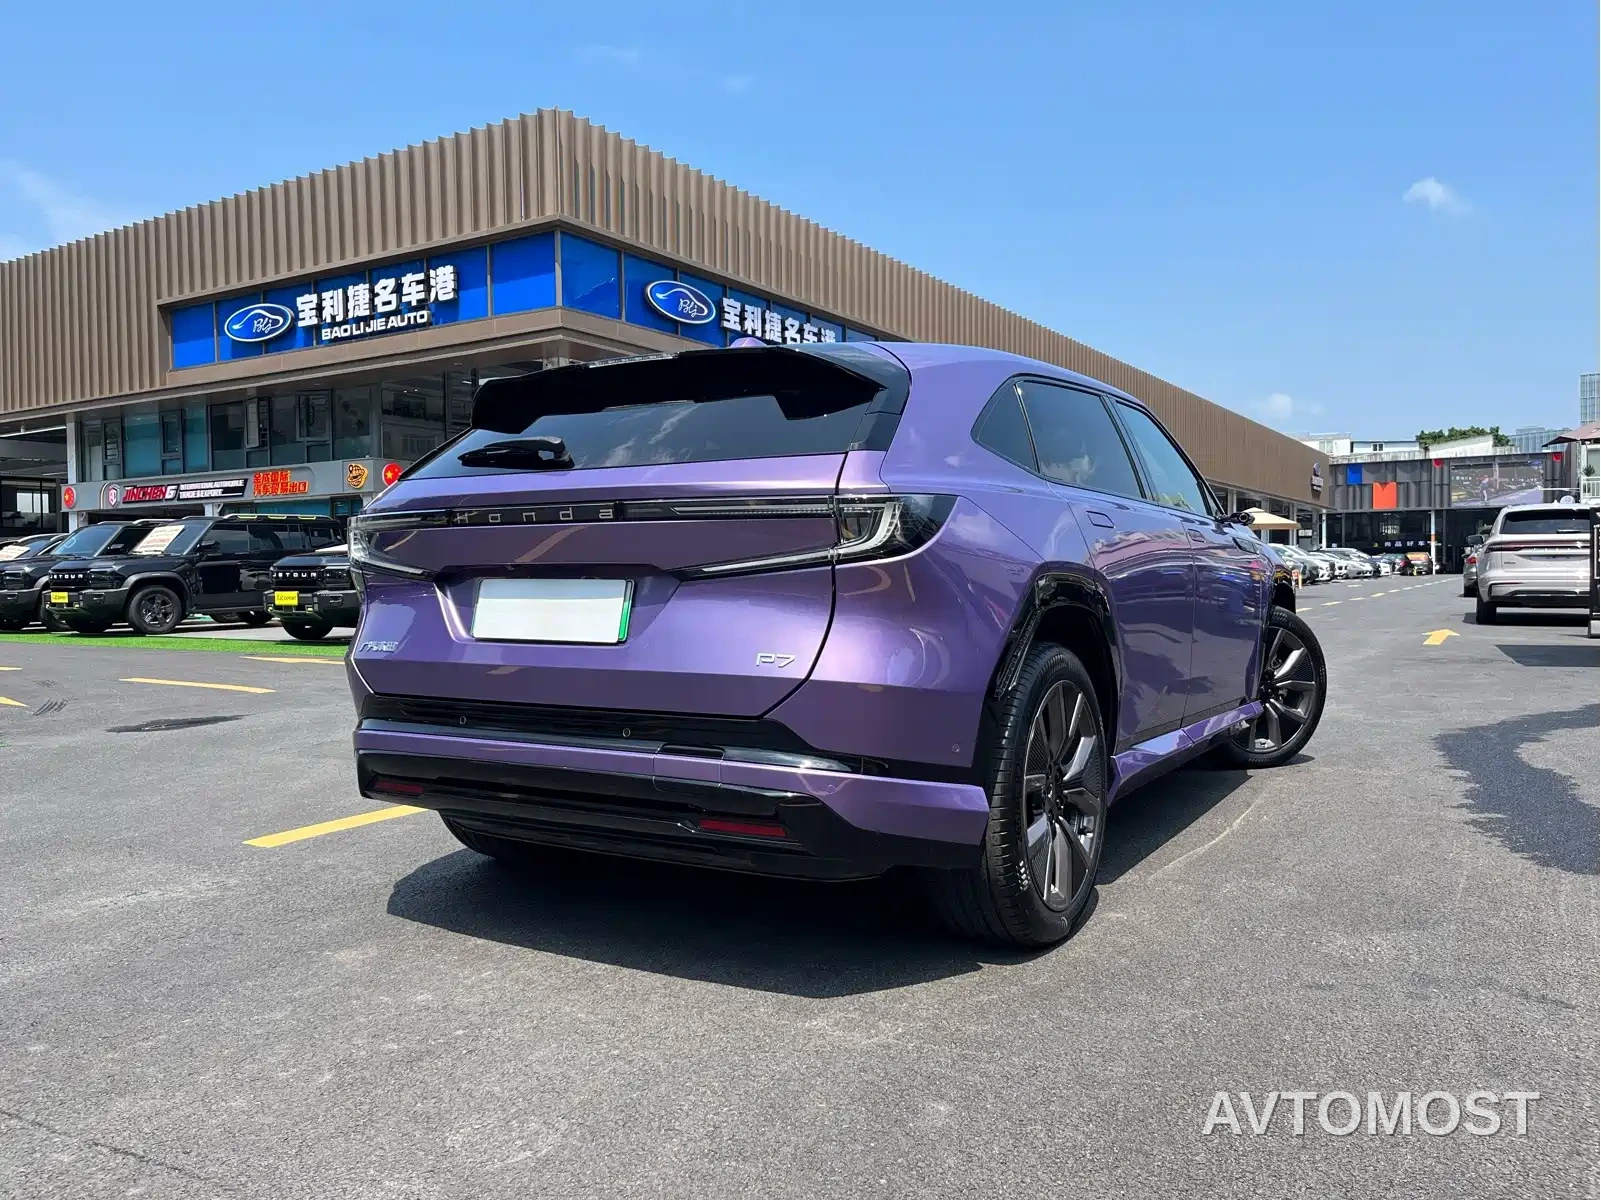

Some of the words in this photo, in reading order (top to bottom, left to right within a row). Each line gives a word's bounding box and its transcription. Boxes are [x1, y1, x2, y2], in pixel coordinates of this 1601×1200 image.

[296, 265, 457, 327] 宝利捷名车港
[756, 652, 796, 669] P7
